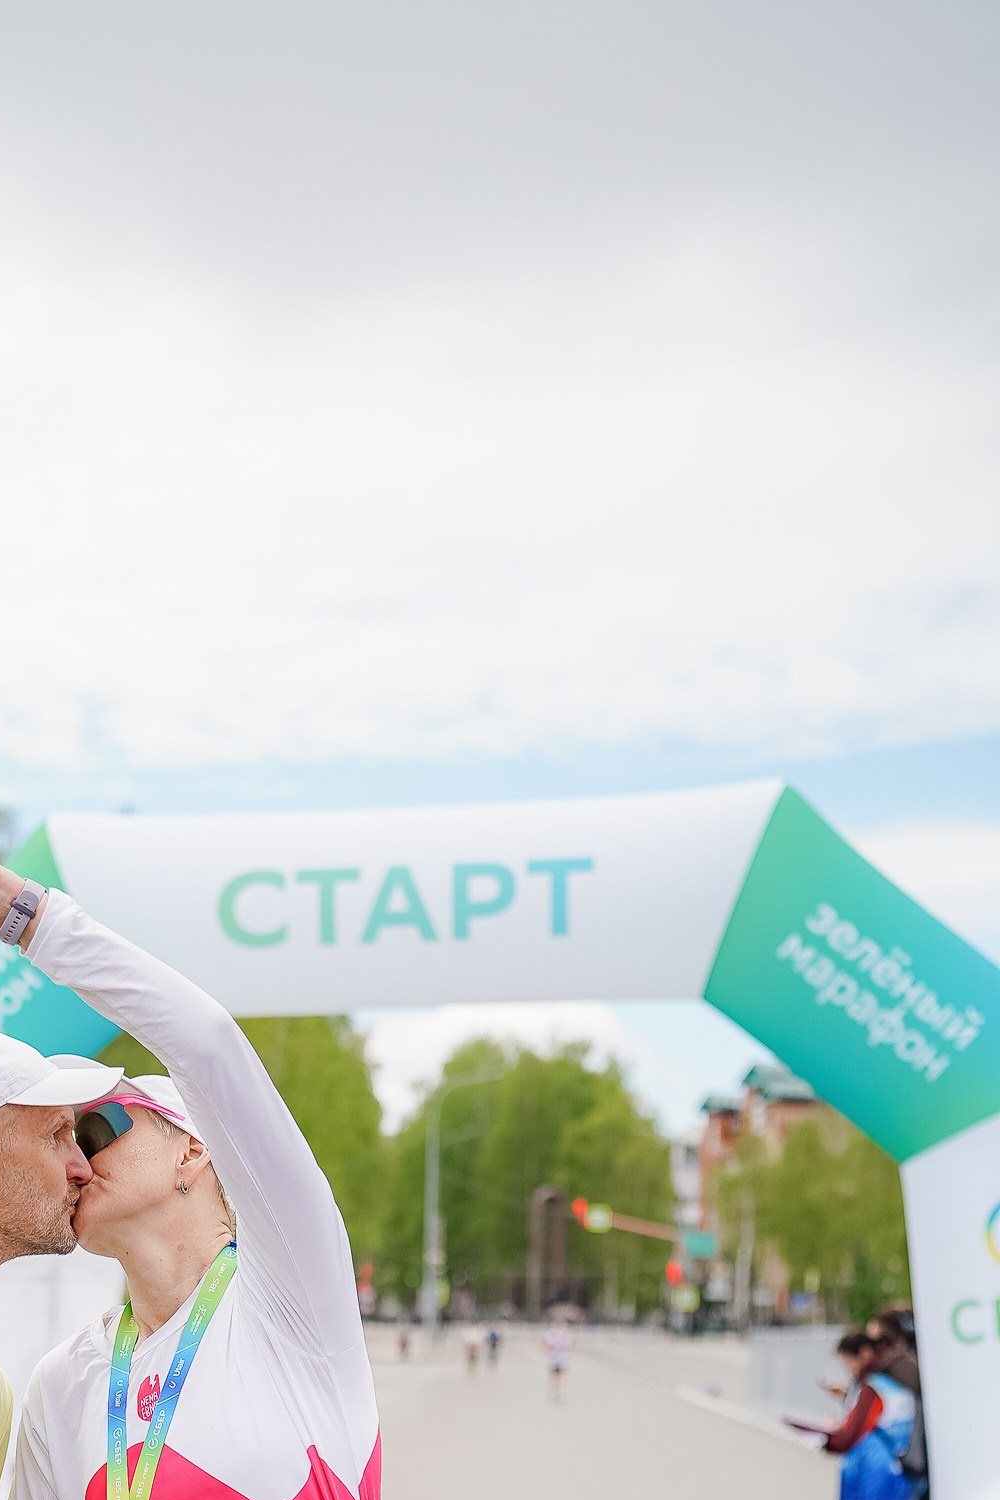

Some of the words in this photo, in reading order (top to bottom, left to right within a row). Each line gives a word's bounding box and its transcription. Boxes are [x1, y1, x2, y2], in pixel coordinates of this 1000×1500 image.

[217, 857, 594, 948] СТАРТ
[805, 902, 985, 1051] зелёный
[776, 933, 951, 1082] марафон
[208, 1278, 220, 1293] 185
[172, 1358, 185, 1377] Utair
[153, 1408, 166, 1436] СБЕР
[114, 1440, 122, 1466] СБЕР
